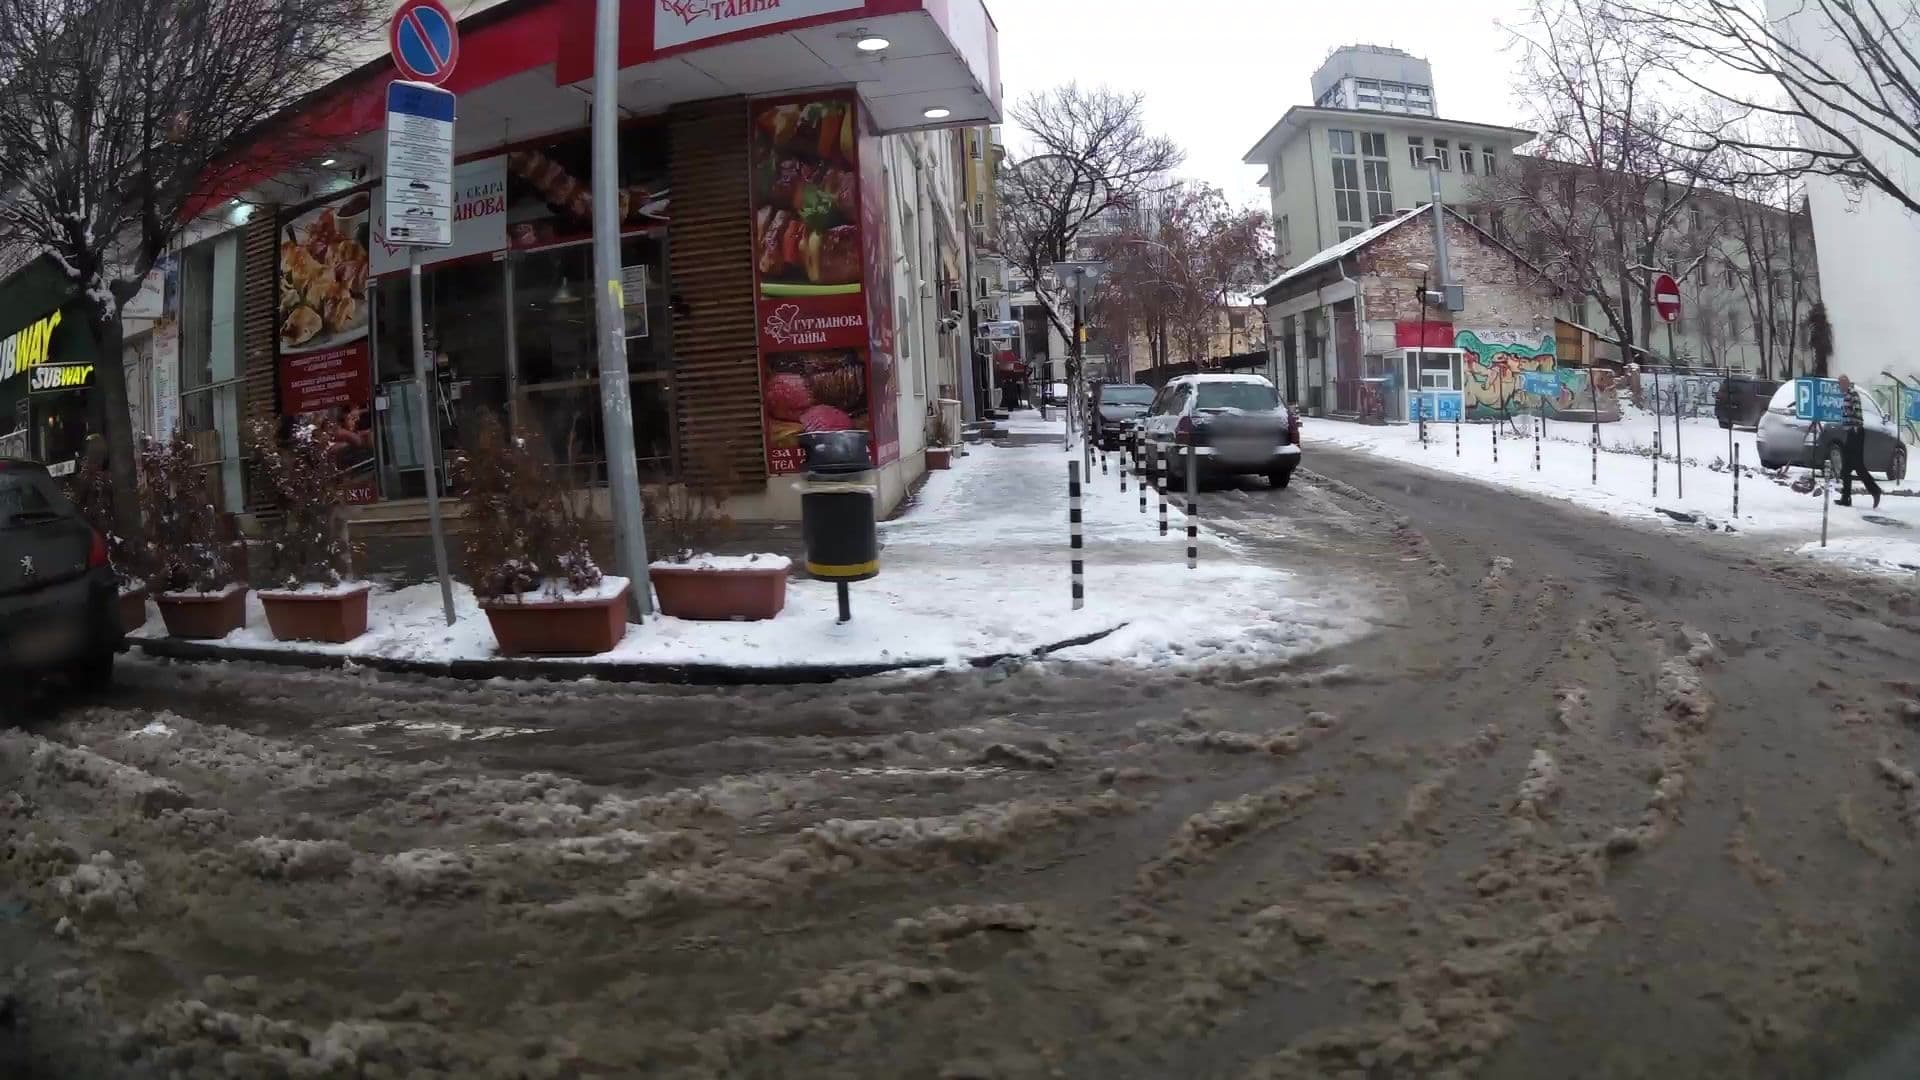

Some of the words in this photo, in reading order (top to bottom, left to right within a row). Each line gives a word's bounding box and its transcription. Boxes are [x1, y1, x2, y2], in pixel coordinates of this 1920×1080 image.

[454, 195, 505, 222] АНОВА
[794, 315, 863, 331] ГУРМАНОВА
[0, 308, 62, 383] UBWAY
[791, 331, 826, 344] ТАЙНА
[31, 365, 94, 389] SUBWAY
[1800, 385, 1810, 412] P
